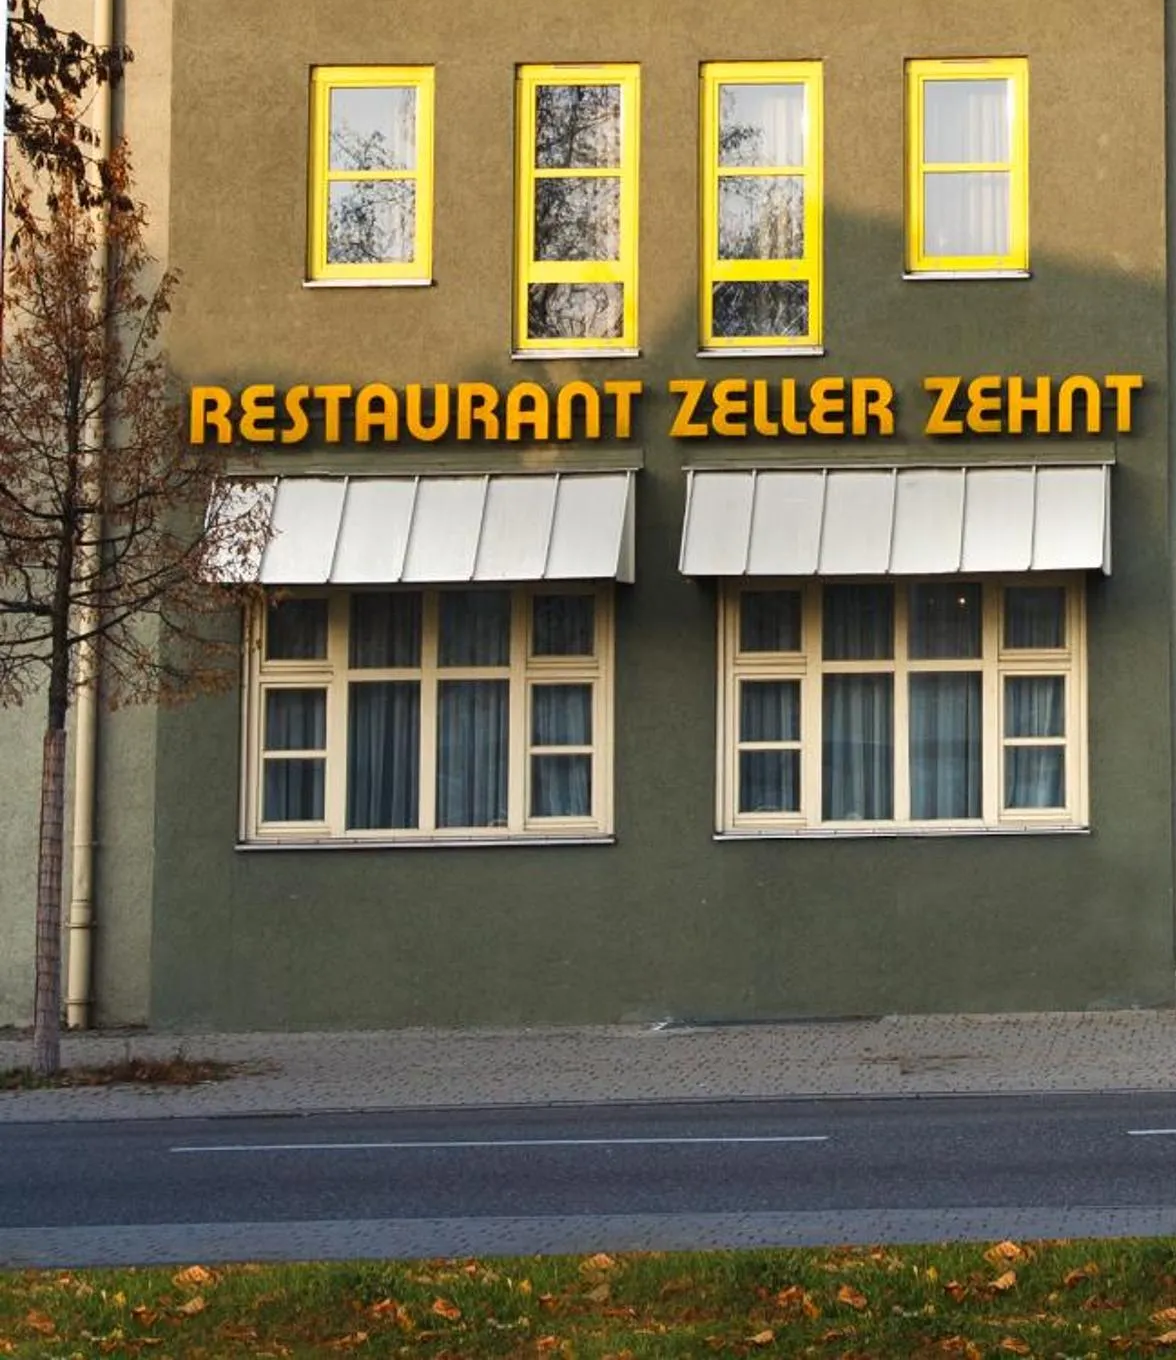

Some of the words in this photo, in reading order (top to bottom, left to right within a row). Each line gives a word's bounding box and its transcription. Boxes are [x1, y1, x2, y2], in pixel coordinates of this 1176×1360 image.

[189, 378, 643, 444] RESTAURANT
[667, 376, 895, 438] ZELLER
[922, 374, 1144, 435] ZEHNT
